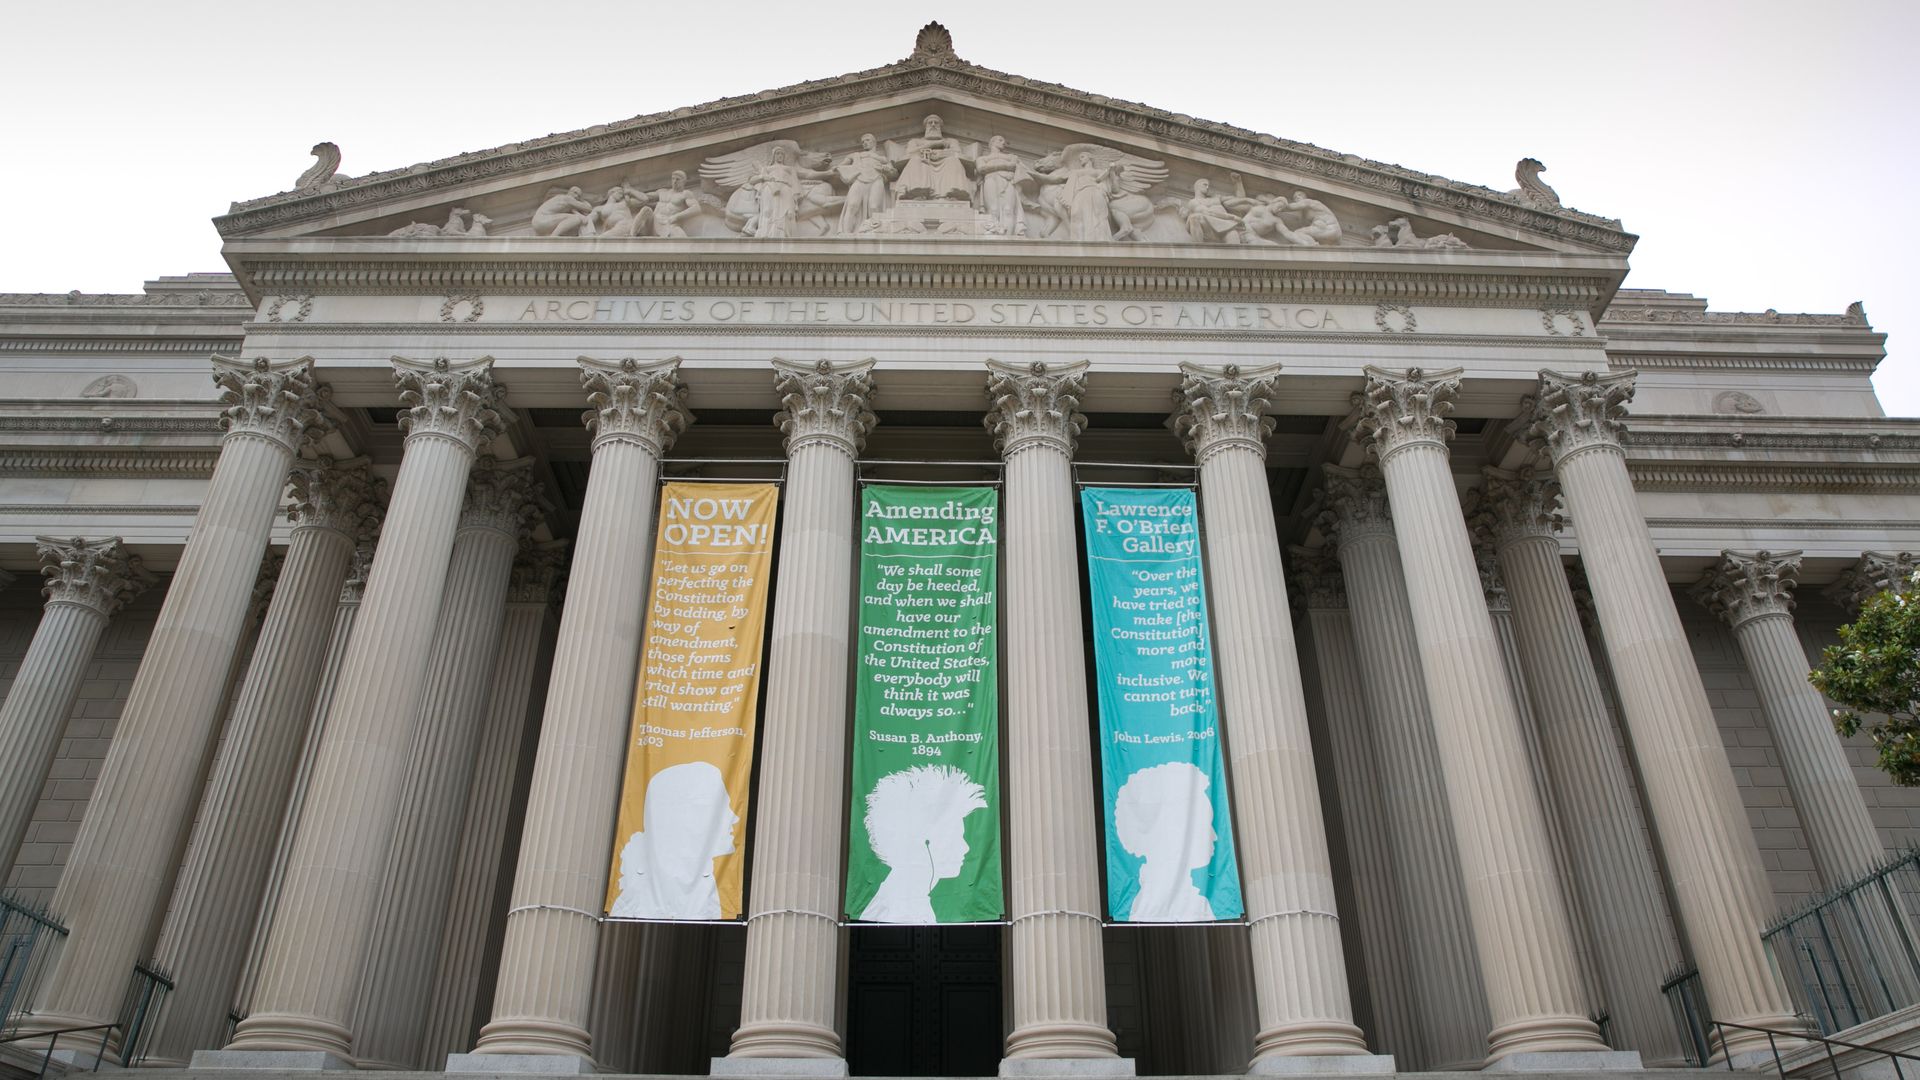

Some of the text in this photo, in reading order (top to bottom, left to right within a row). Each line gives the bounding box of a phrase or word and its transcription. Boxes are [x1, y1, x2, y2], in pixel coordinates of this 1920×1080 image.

[517, 300, 1343, 330] ARCHIVES OF THE UNITED STATES OF AMERICA
[667, 498, 754, 520] NOW
[865, 500, 994, 524] Amending
[1096, 501, 1192, 517] Lawrence
[1096, 519, 1194, 534] F. O'Brien
[664, 524, 768, 546] OPEN!
[864, 526, 996, 546] AMERICA
[1122, 536, 1195, 554] Gallery
[708, 564, 726, 576] go
[908, 564, 942, 576] shall
[945, 567, 982, 577] some
[1176, 567, 1197, 580] the
[657, 576, 753, 590] perfecting the
[876, 578, 980, 594] day be heeded,
[1133, 582, 1198, 598] years, we
[656, 589, 744, 603] Constitution
[864, 592, 992, 608] and when we shall
[1113, 596, 1200, 610] have tried to
[654, 603, 748, 621] by adding, by
[896, 610, 961, 623] have our
[1134, 609, 1201, 626] make [the
[652, 620, 702, 636] way of
[864, 622, 992, 638] amendment to the
[1111, 623, 1203, 640] Constitution]
[650, 635, 738, 648] amendment,
[873, 638, 984, 654] Constitution of
[1137, 640, 1205, 656] more and
[648, 647, 732, 666] those forms
[864, 654, 989, 670] the United States,
[1171, 657, 1206, 669] more
[646, 663, 756, 679] which time and
[874, 670, 980, 688] everybody will
[1117, 669, 1208, 686] inclusive. We
[678, 682, 716, 696] show
[720, 684, 744, 695] are
[884, 688, 970, 701] think it was
[1124, 688, 1210, 702] cannot turn
[880, 703, 933, 720] always
[640, 722, 747, 740] Thomas Jefferson,
[869, 730, 983, 743] Susan B. Anthony,
[1114, 728, 1214, 744] John Lewis, 2006
[912, 746, 942, 756] 1894
